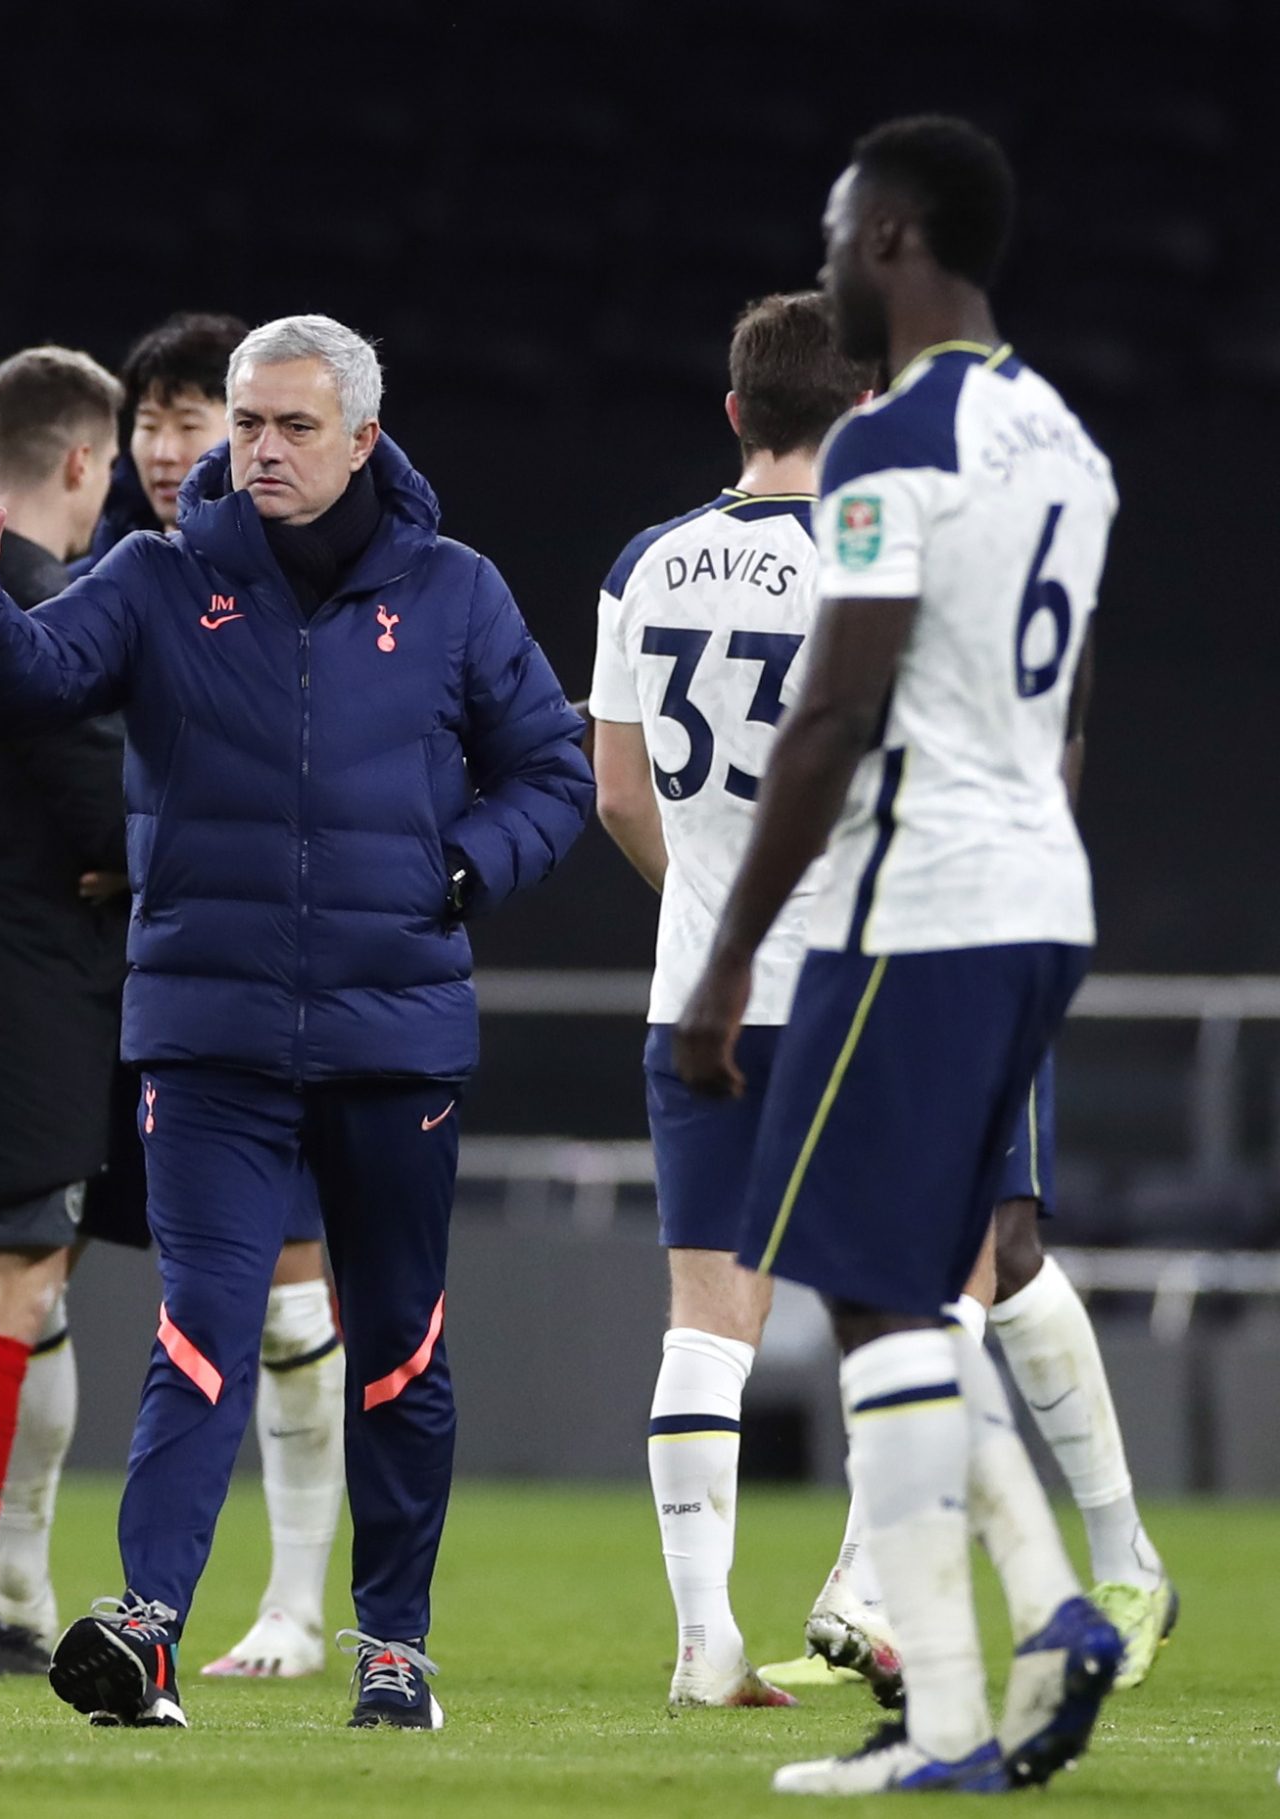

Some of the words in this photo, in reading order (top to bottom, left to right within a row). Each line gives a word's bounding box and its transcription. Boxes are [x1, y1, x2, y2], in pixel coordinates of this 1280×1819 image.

[665, 547, 797, 596] DAVIES
[208, 594, 234, 612] JM
[1015, 503, 1071, 698] 6
[640, 625, 806, 801] 33
[662, 1502, 701, 1515] SPURS
